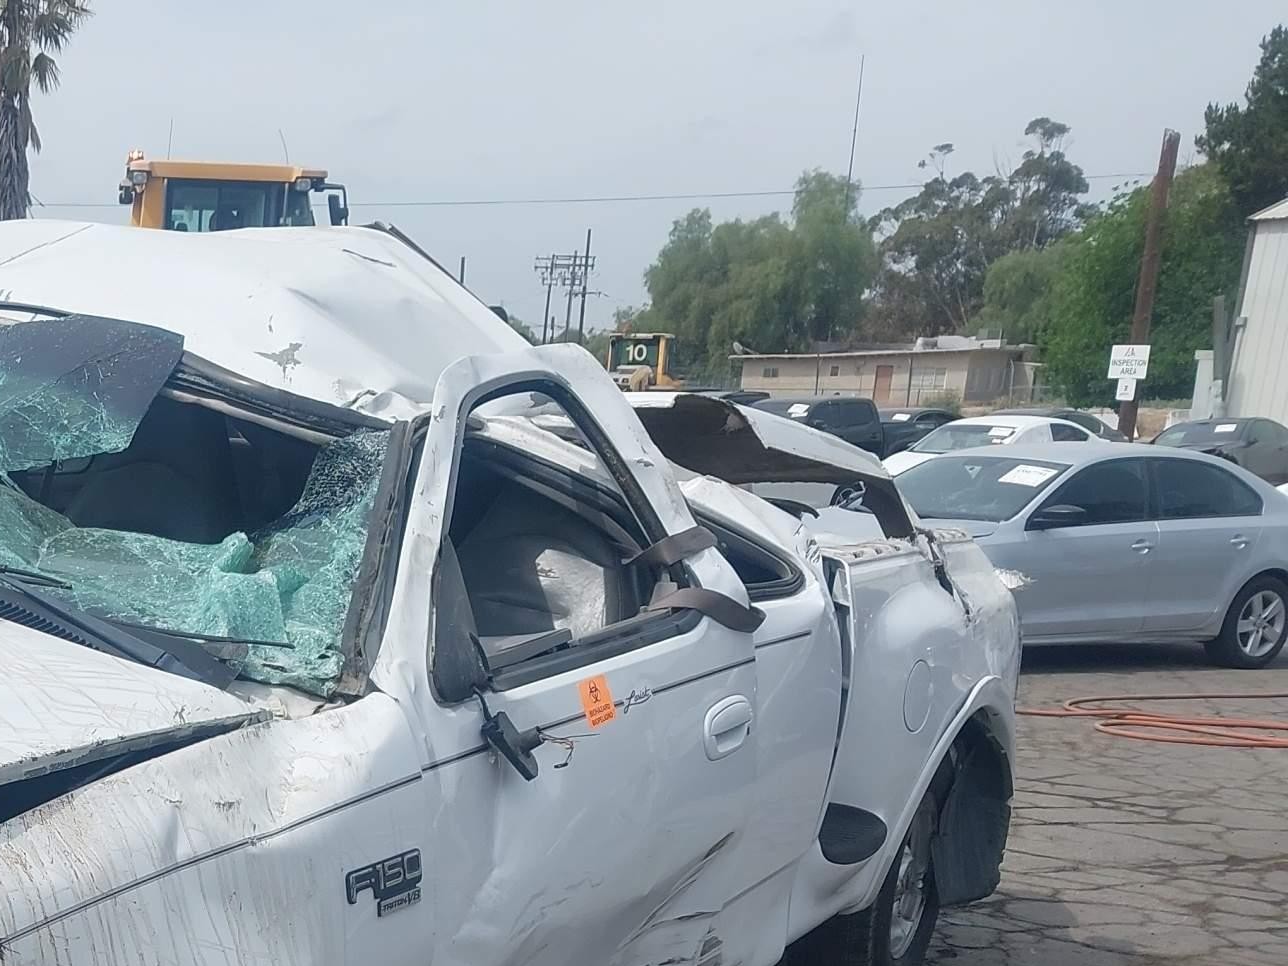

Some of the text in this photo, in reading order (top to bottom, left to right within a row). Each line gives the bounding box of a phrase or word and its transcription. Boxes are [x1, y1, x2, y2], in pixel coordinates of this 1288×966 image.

[626, 343, 647, 361] 10
[1112, 359, 1147, 367] INSPECTION
[1120, 367, 1137, 375] AREA
